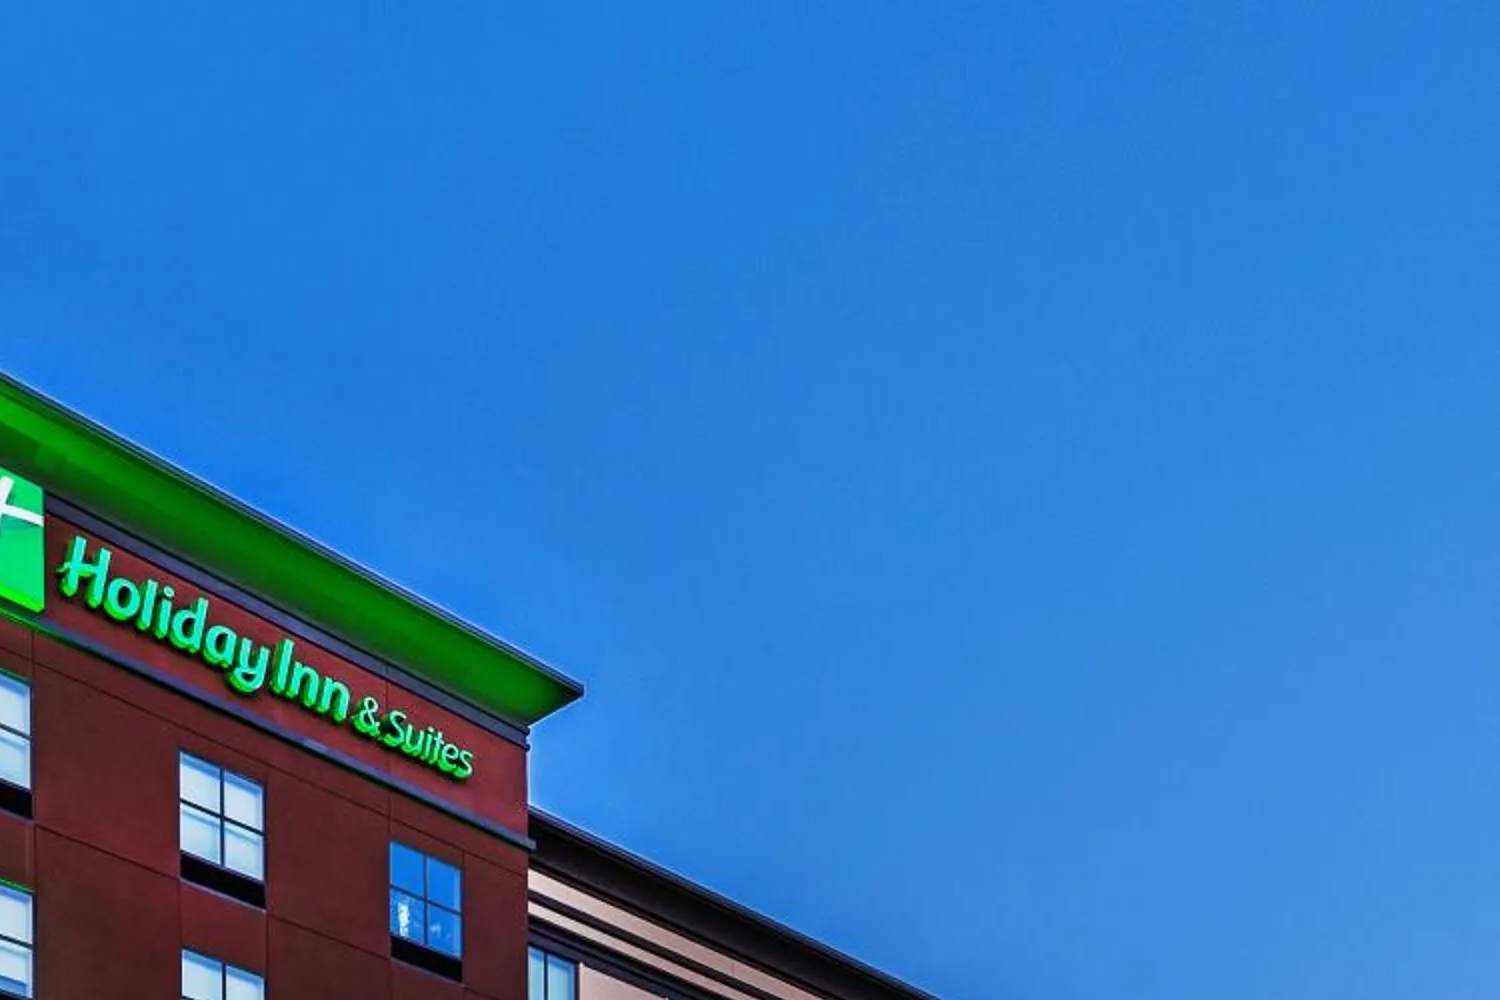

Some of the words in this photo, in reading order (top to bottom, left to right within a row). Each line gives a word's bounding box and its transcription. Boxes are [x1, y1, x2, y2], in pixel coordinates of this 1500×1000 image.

[56, 535, 270, 693] Holiday
[269, 638, 350, 722] Inn
[352, 696, 381, 737] &
[384, 710, 474, 779] Suites
